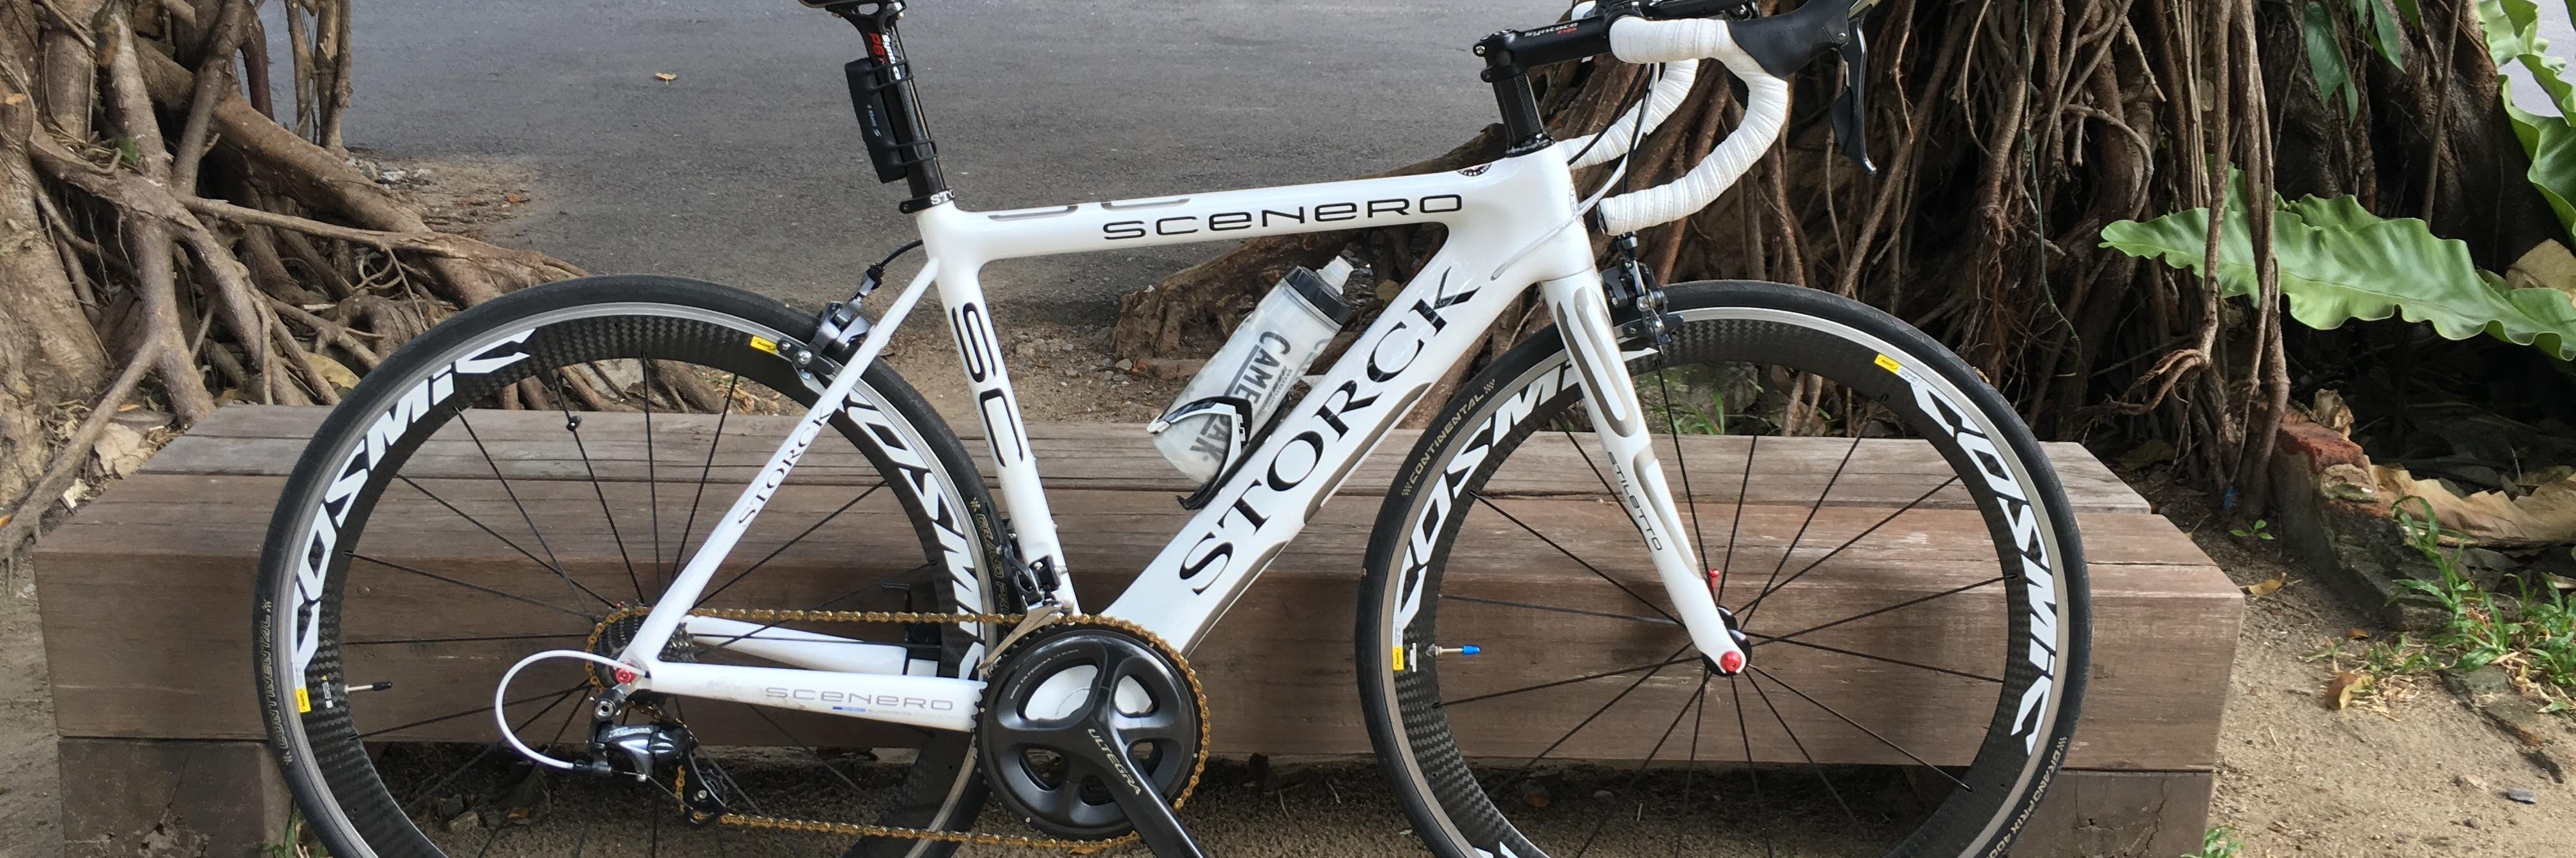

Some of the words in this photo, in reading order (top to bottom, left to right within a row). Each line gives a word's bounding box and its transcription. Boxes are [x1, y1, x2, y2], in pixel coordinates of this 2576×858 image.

[739, 405, 833, 528] STORCK
[1179, 266, 1482, 595] STORCK
[1409, 392, 1486, 486] CONTINENTAL
[261, 615, 289, 751] CONTINENTAL
[1087, 728, 1142, 796] ULTEGRA
[1986, 832, 2012, 858] 400
